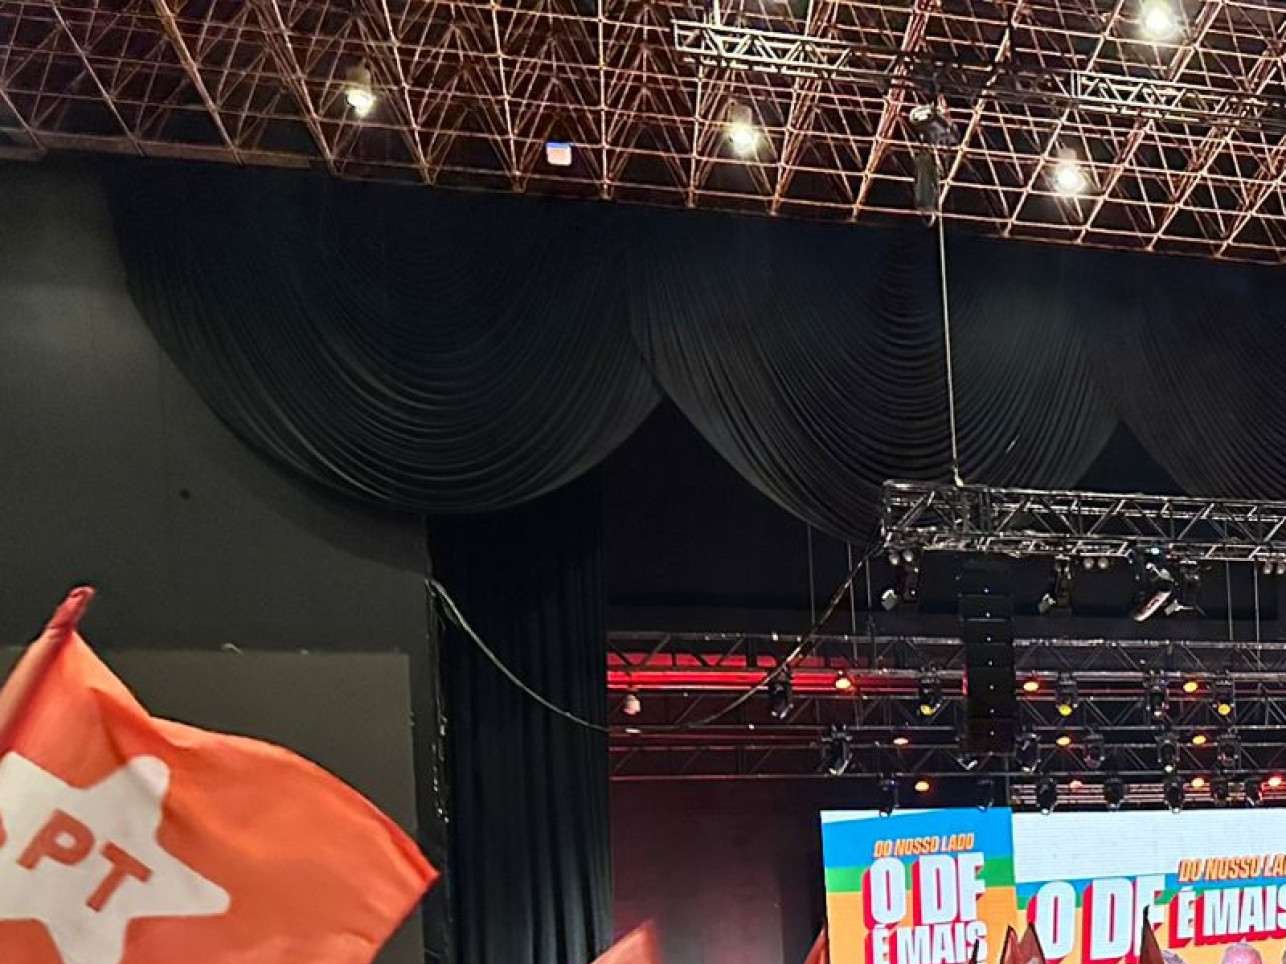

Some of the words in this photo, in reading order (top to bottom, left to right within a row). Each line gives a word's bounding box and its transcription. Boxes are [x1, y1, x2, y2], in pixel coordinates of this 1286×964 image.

[16, 808, 154, 912] PT
[869, 857, 906, 925] O
[918, 851, 986, 925] DF
[1202, 854, 1262, 881] NOSSO
[1036, 881, 1077, 960] O
[1089, 873, 1167, 961] DF
[1176, 885, 1197, 940] É
